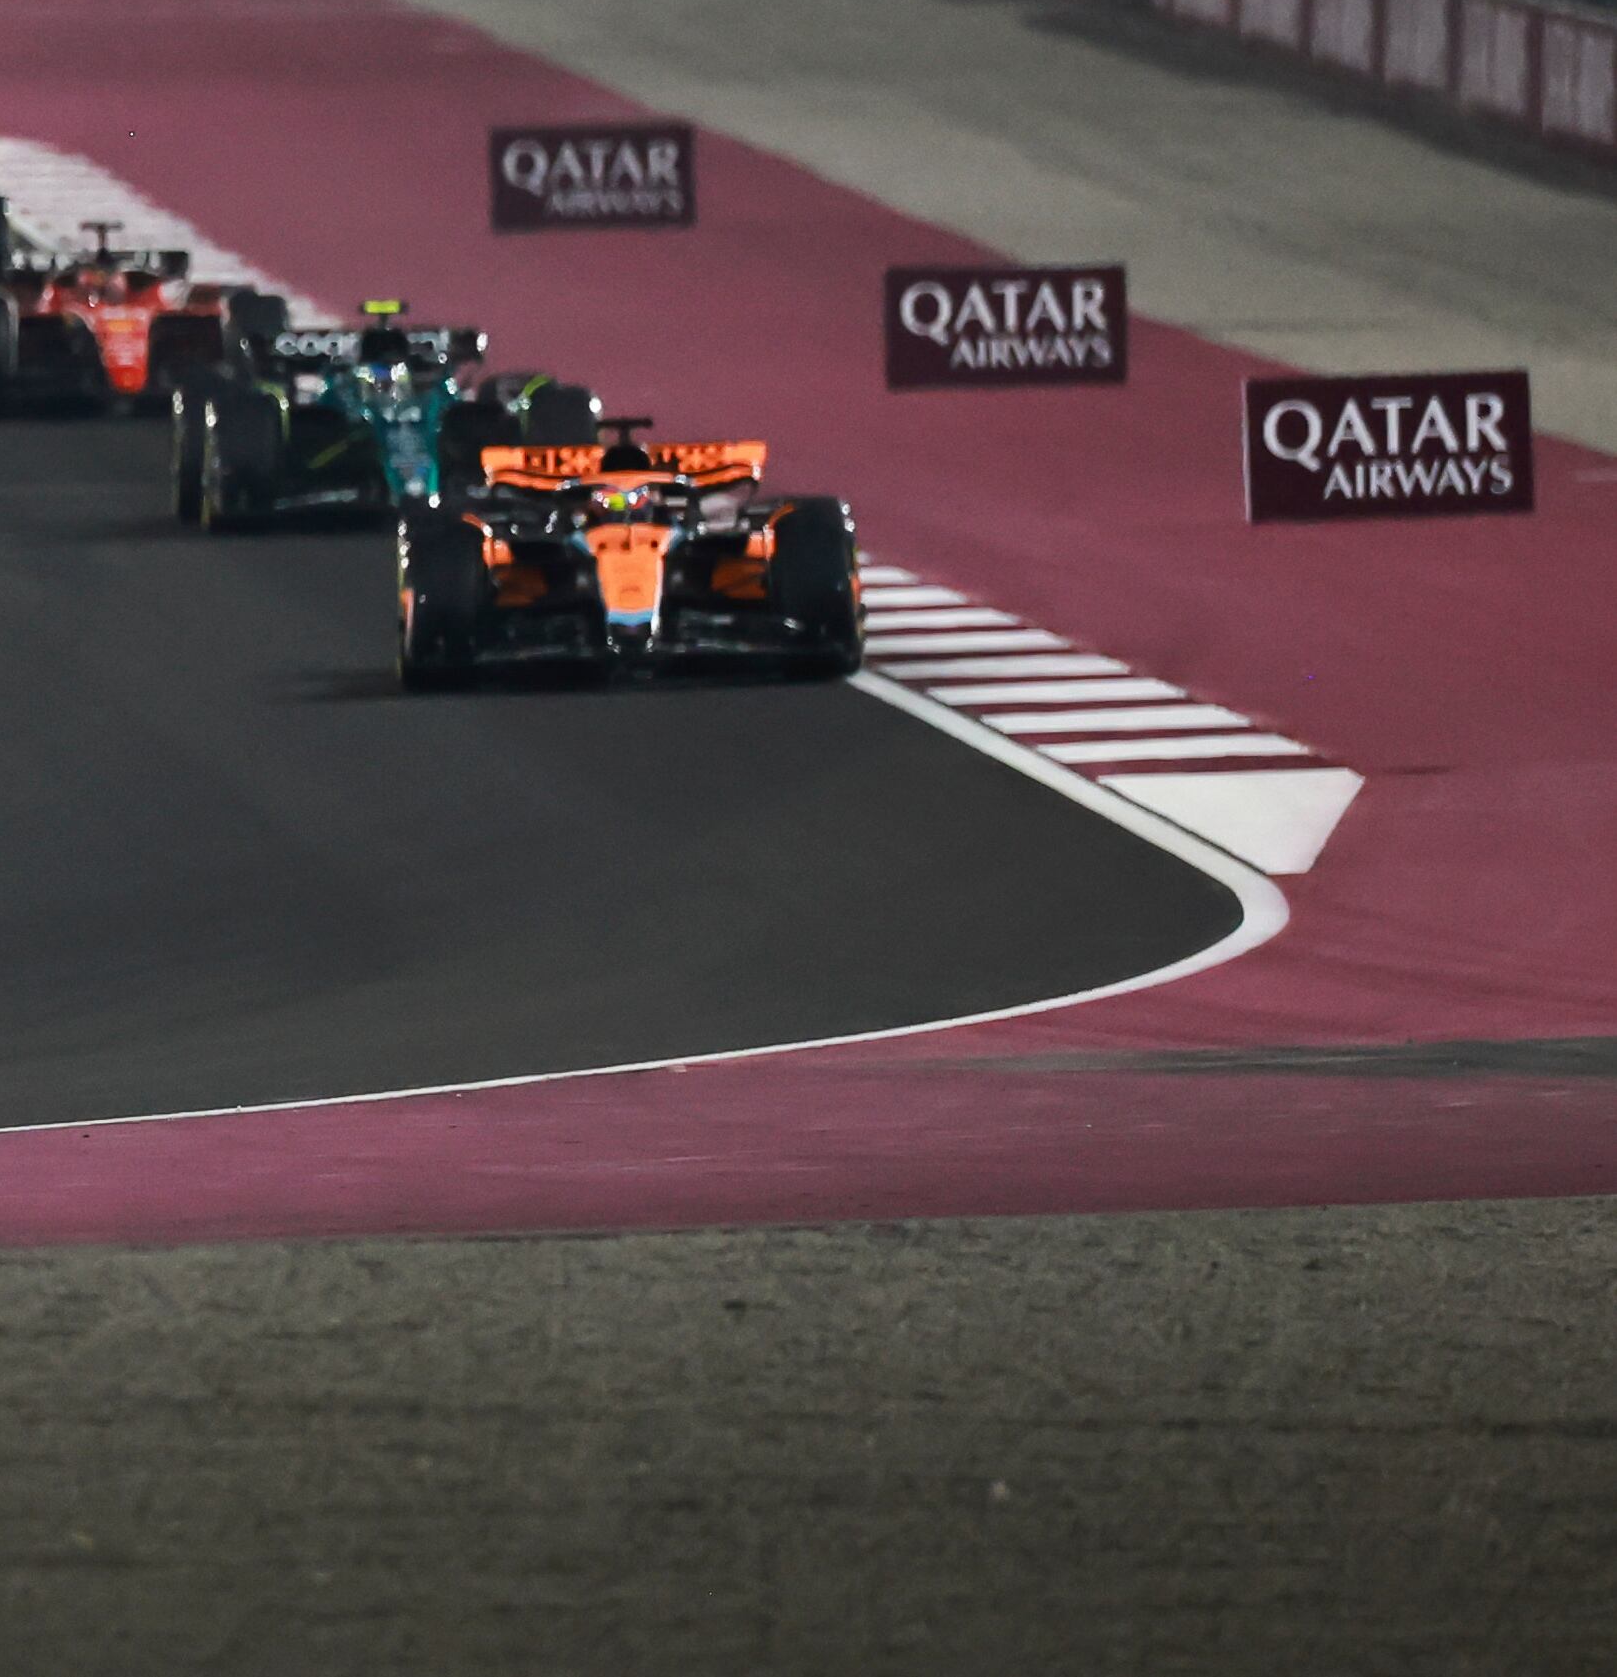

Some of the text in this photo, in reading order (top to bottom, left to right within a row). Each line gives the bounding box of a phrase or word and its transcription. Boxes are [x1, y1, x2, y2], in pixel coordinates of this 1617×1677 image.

[503, 138, 680, 199] QATAR
[900, 280, 1106, 347] QATAR
[951, 335, 1112, 370] AIRWAYS
[1263, 391, 1508, 472] QATAR
[1323, 456, 1512, 501] AIRWAYS
